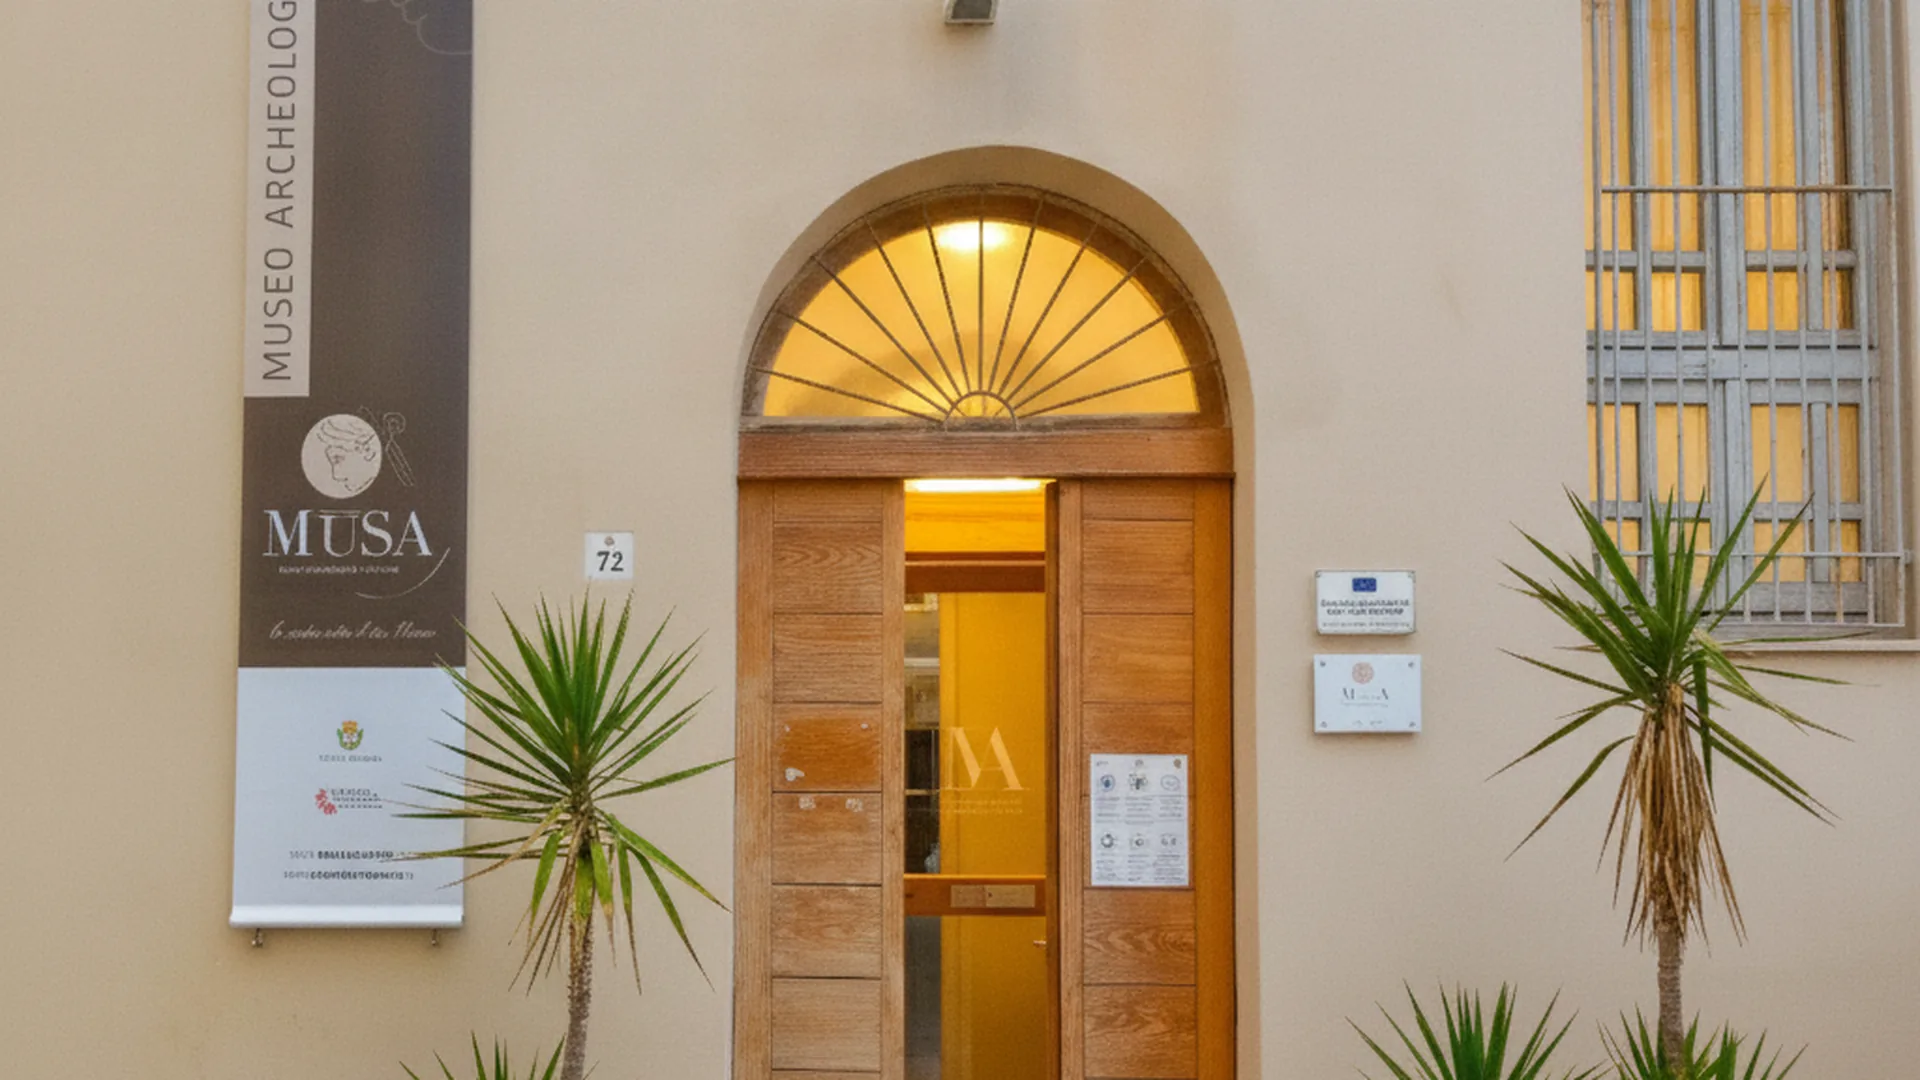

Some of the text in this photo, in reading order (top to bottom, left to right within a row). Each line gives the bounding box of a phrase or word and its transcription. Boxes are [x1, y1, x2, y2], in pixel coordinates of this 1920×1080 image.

[263, 1, 298, 381] MUSEO ARCHEOLOG
[263, 509, 433, 558] MUSA
[596, 550, 625, 572] 72
